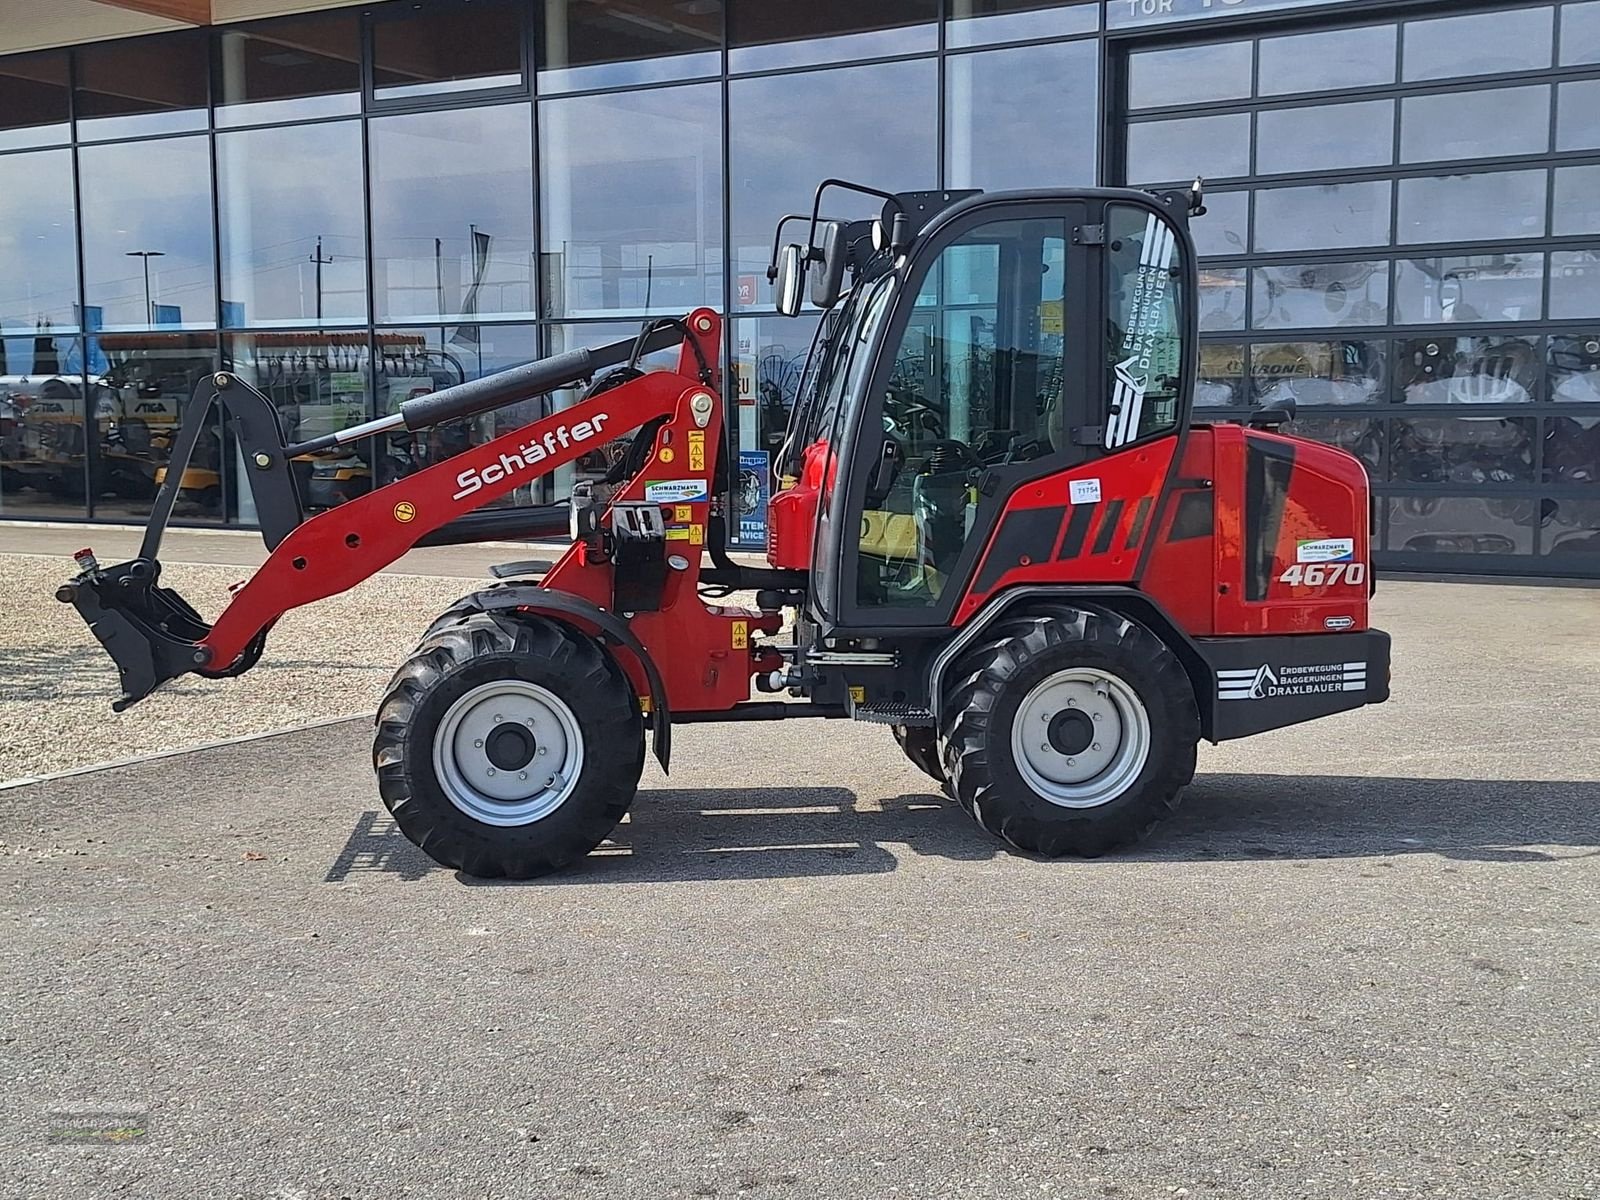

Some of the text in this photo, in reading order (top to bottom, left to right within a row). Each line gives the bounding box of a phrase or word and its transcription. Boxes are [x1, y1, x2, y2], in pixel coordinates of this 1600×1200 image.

[1128, 0, 1173, 17] TOR
[452, 412, 609, 501] Schäffer
[1280, 563, 1365, 586] 4670
[1268, 683, 1342, 697] DRAXLBAUER
